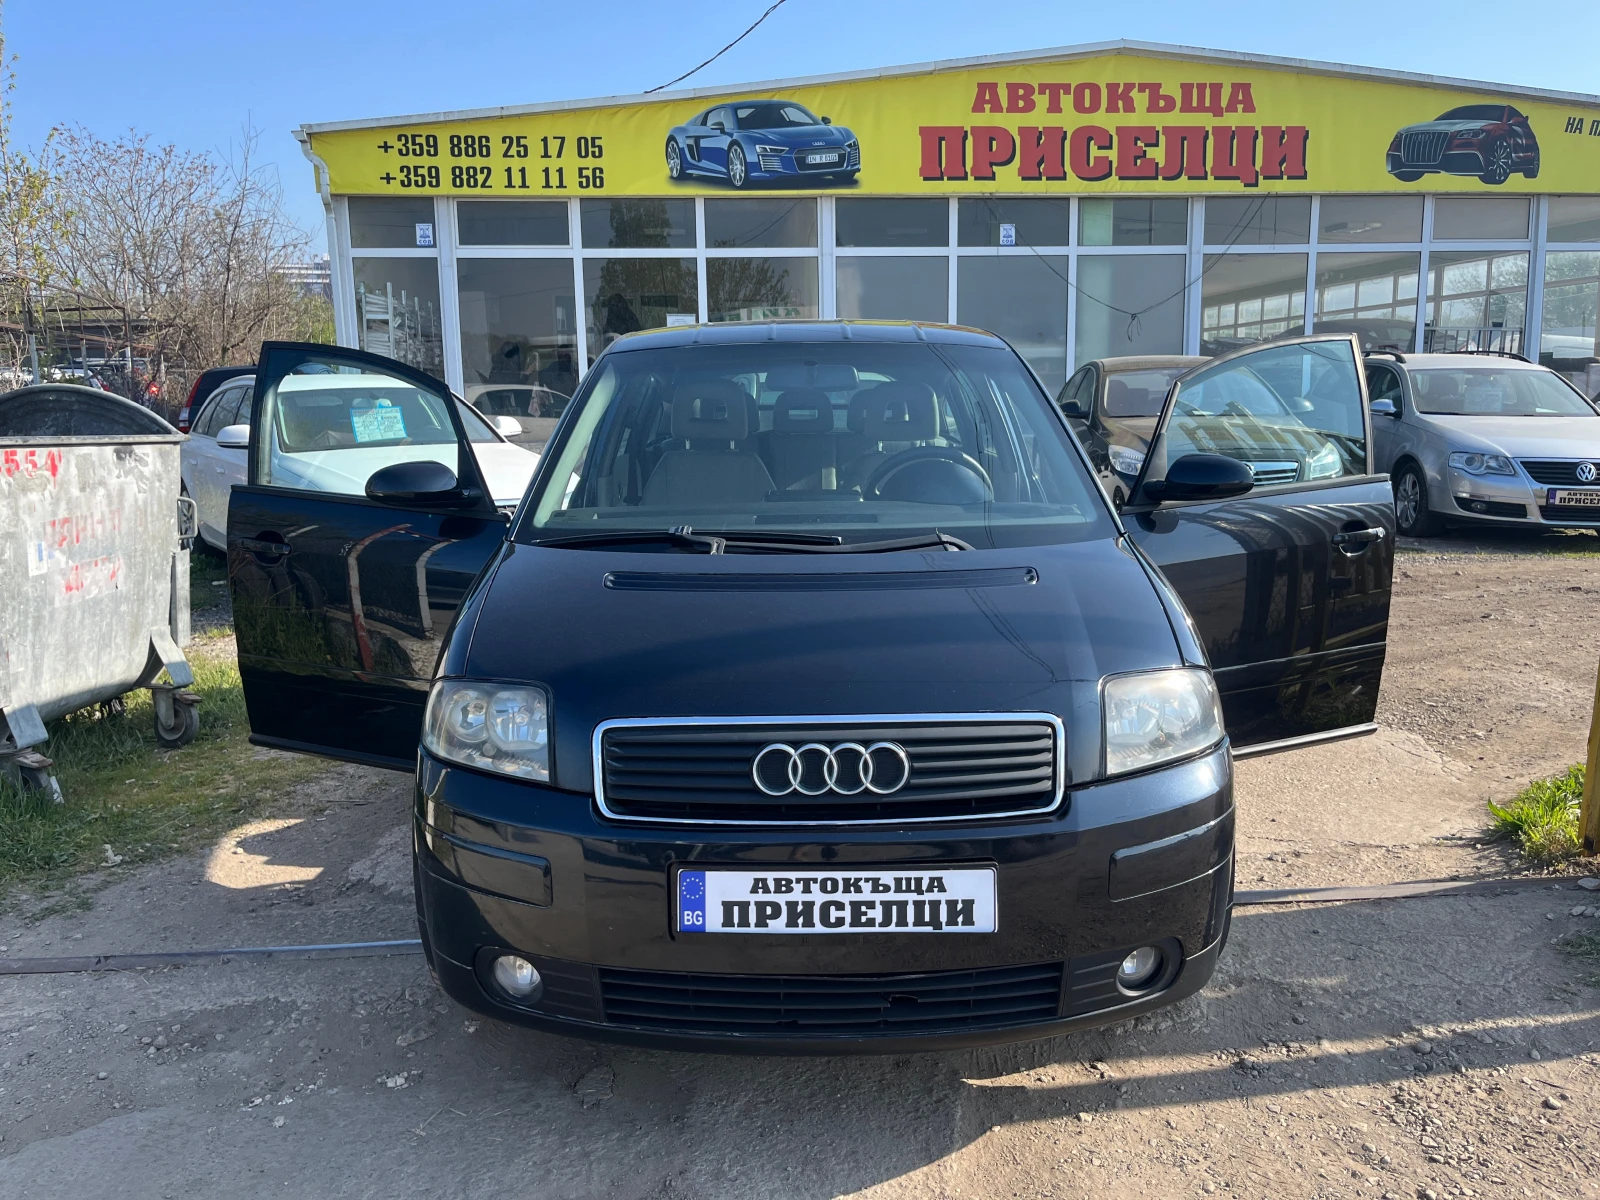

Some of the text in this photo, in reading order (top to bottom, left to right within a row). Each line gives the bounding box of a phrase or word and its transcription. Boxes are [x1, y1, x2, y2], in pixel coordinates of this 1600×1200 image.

[971, 82, 1257, 117] АВТОКЪЩА
[1564, 116, 1600, 136] НА П
[377, 134, 604, 159] +359 886 25 17 05
[918, 125, 1309, 187] ПРИСЕЛЦИ
[380, 165, 605, 189] +359 882 11 11 56
[749, 876, 947, 896] АВТОКЪЩА
[684, 910, 703, 925] BG
[721, 899, 976, 930] ПРИСЕЛЦИ
